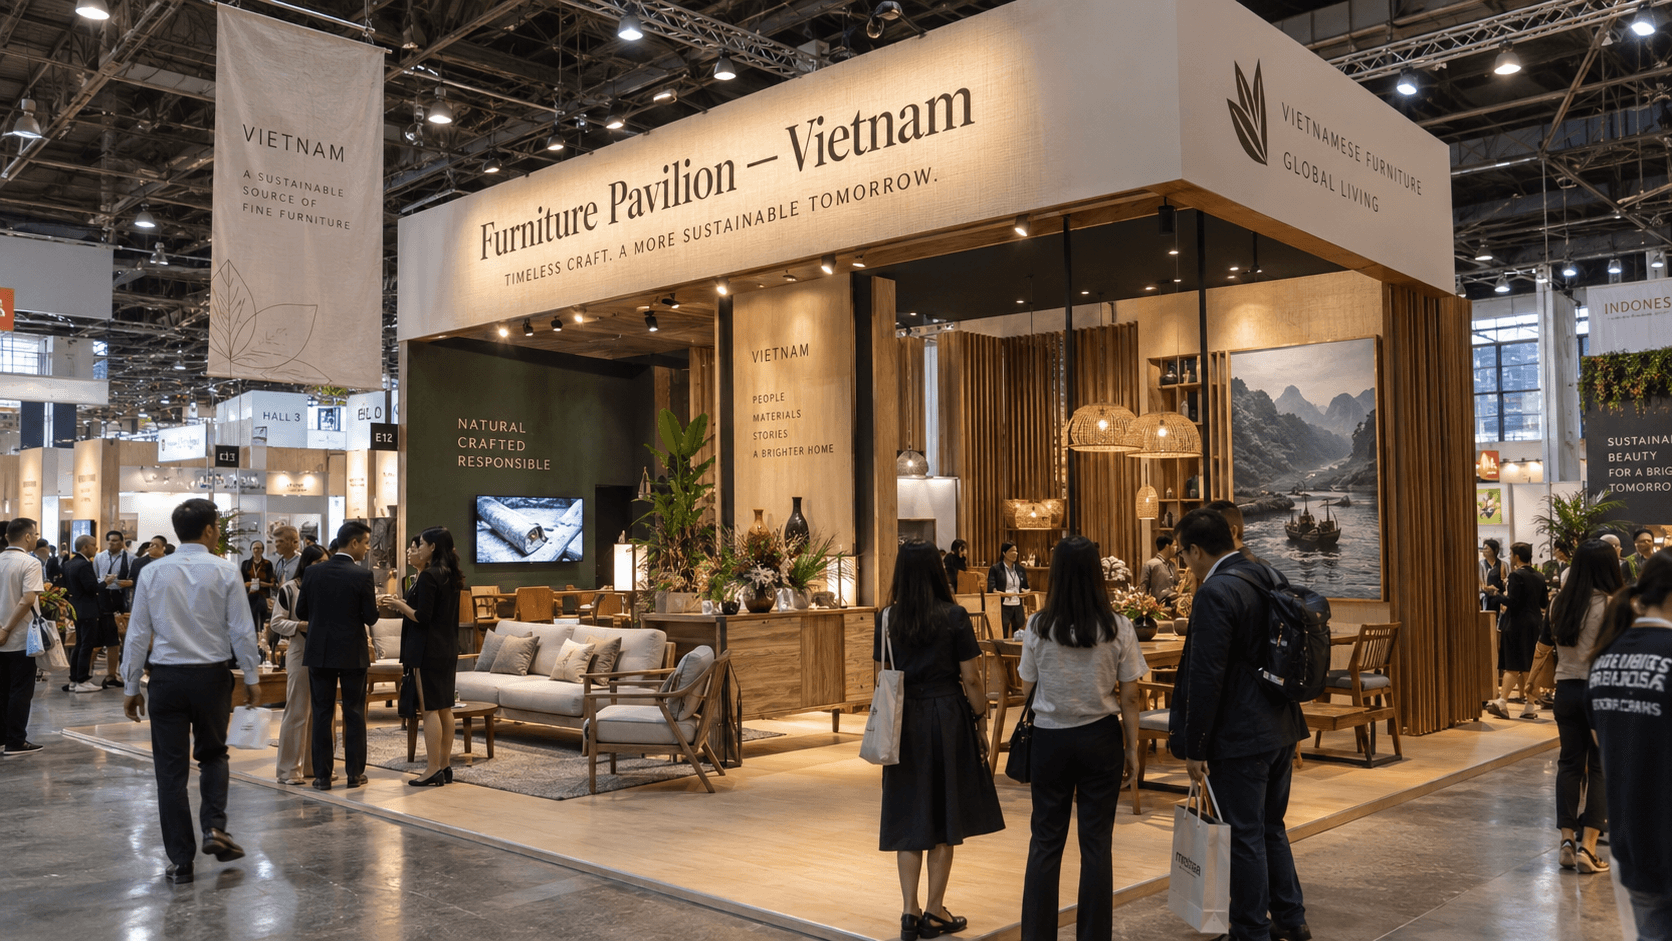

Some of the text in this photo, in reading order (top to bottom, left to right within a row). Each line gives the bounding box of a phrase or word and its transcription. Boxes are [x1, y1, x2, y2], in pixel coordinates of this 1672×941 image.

[243, 123, 344, 163] VIETNAM
[1281, 101, 1422, 196] VIETNAMESE FURNITURE
[480, 201, 598, 261] Furniture
[608, 158, 737, 226] Pavilion
[785, 87, 976, 172] Vietnam
[1283, 151, 1380, 213] GLOBAL LIVING
[242, 169, 344, 198] A SUSTAINABLE
[242, 185, 317, 208] SOURCE OF
[242, 202, 351, 230] FINE FURNITURE
[504, 166, 938, 287] TIMELESS CRAFT. A MORE SUSTAINABLE TOMORROW.
[1604, 296, 1672, 315] INDONES
[751, 343, 809, 364] VIETNAM
[752, 392, 785, 404] PEOPLE
[262, 411, 301, 422] HALL 3
[752, 409, 802, 422] MATERIALS
[457, 417, 526, 434] NATURAL
[375, 432, 393, 443] E12
[752, 429, 788, 441] STORIES
[1607, 434, 1672, 447] SUSTAINA
[457, 436, 526, 452] CRAFTED
[753, 443, 834, 458] A BRIGHTER HOME
[457, 455, 551, 471] RESPONSIBLE
[1608, 450, 1658, 463] BEAUTY
[1608, 467, 1632, 478] FOR
[1634, 467, 1643, 477] A
